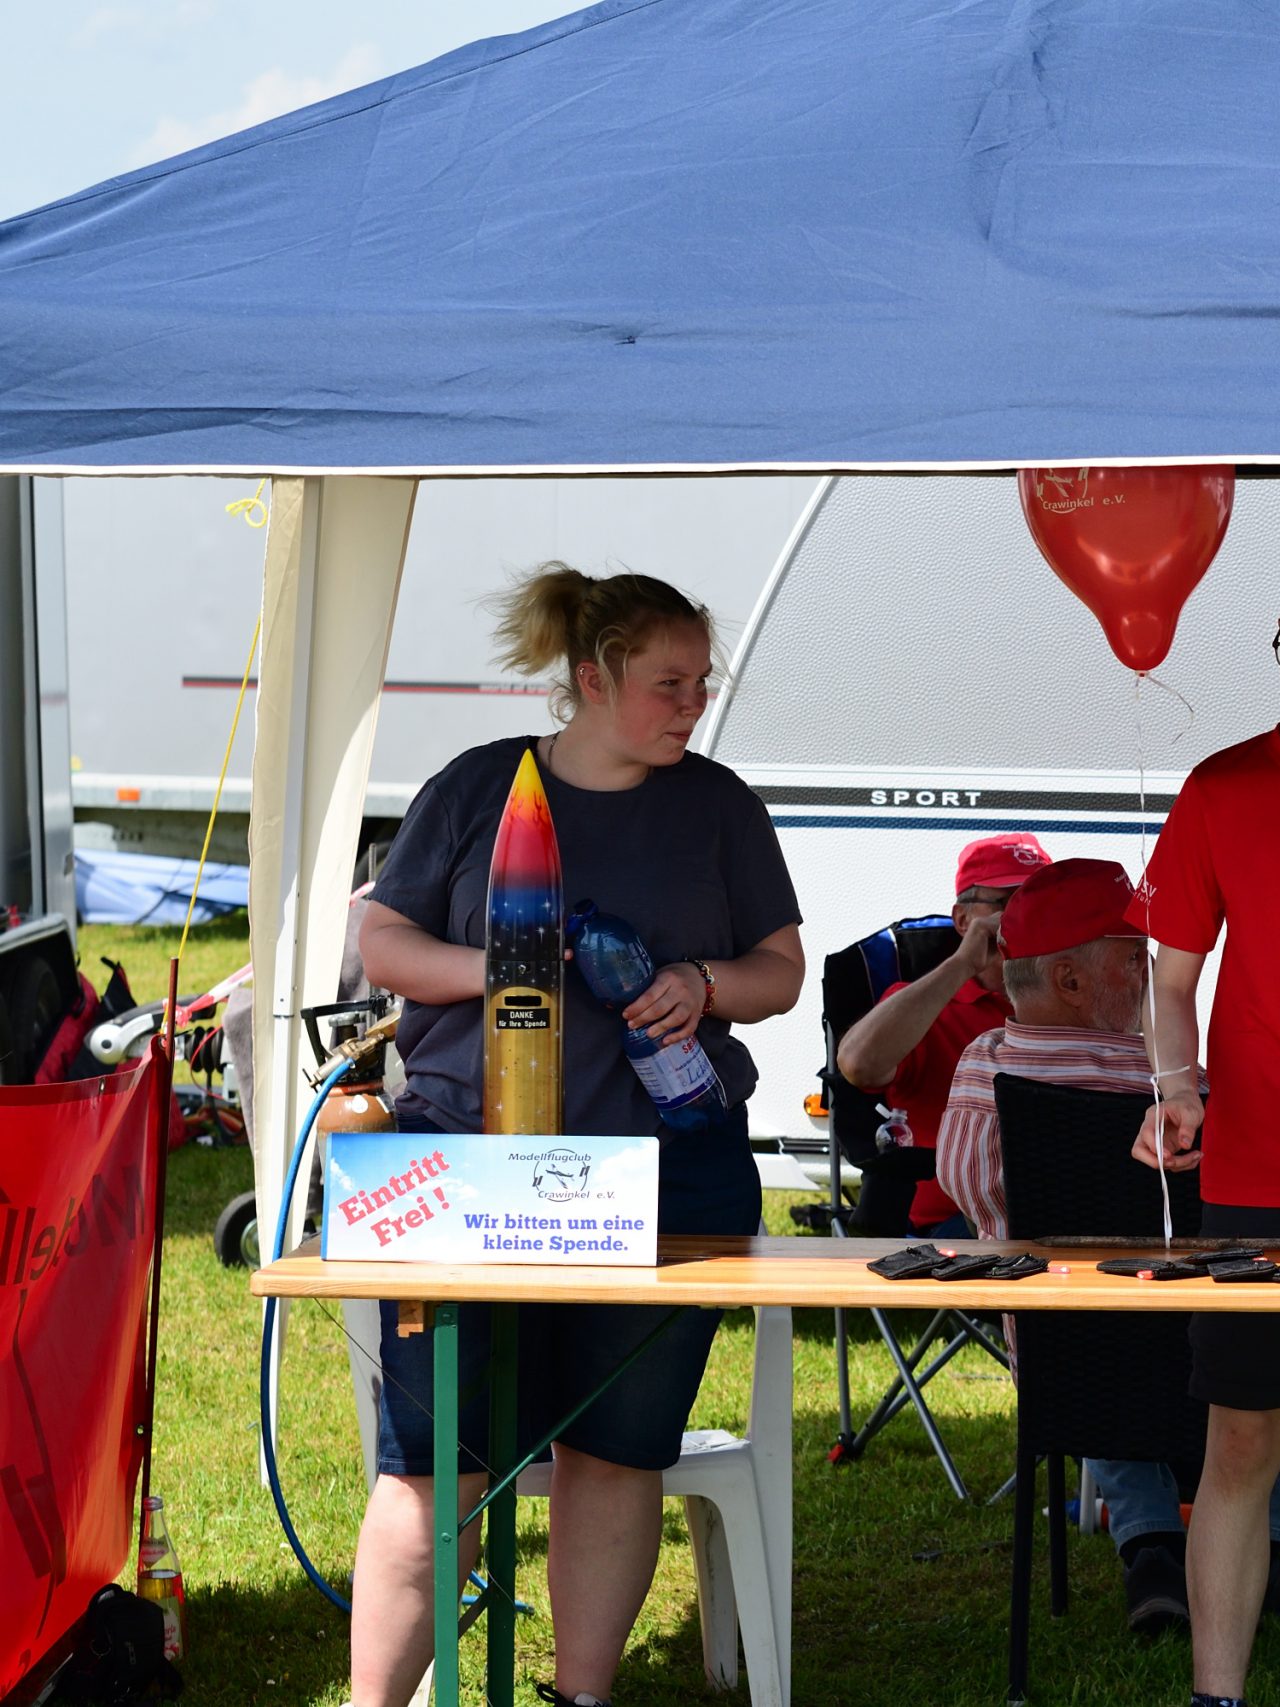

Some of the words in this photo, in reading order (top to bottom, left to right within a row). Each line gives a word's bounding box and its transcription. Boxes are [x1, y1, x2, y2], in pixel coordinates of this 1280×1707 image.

[1042, 497, 1094, 510] Crawinkel
[1103, 494, 1126, 505] e.V.
[870, 790, 981, 807] SPORT
[509, 1011, 534, 1019] DANKE
[524, 1020, 547, 1028] Spende
[508, 1152, 592, 1163] Modellflugclub
[337, 1150, 450, 1226] Eintritt
[537, 1190, 590, 1200] Crawinkel
[596, 1191, 615, 1199] e.V.
[463, 1213, 499, 1229] Wir
[504, 1213, 562, 1230] bitten
[567, 1218, 598, 1230] um
[603, 1215, 645, 1230] eine
[483, 1234, 544, 1250] kleine
[549, 1235, 629, 1254] Spende.
